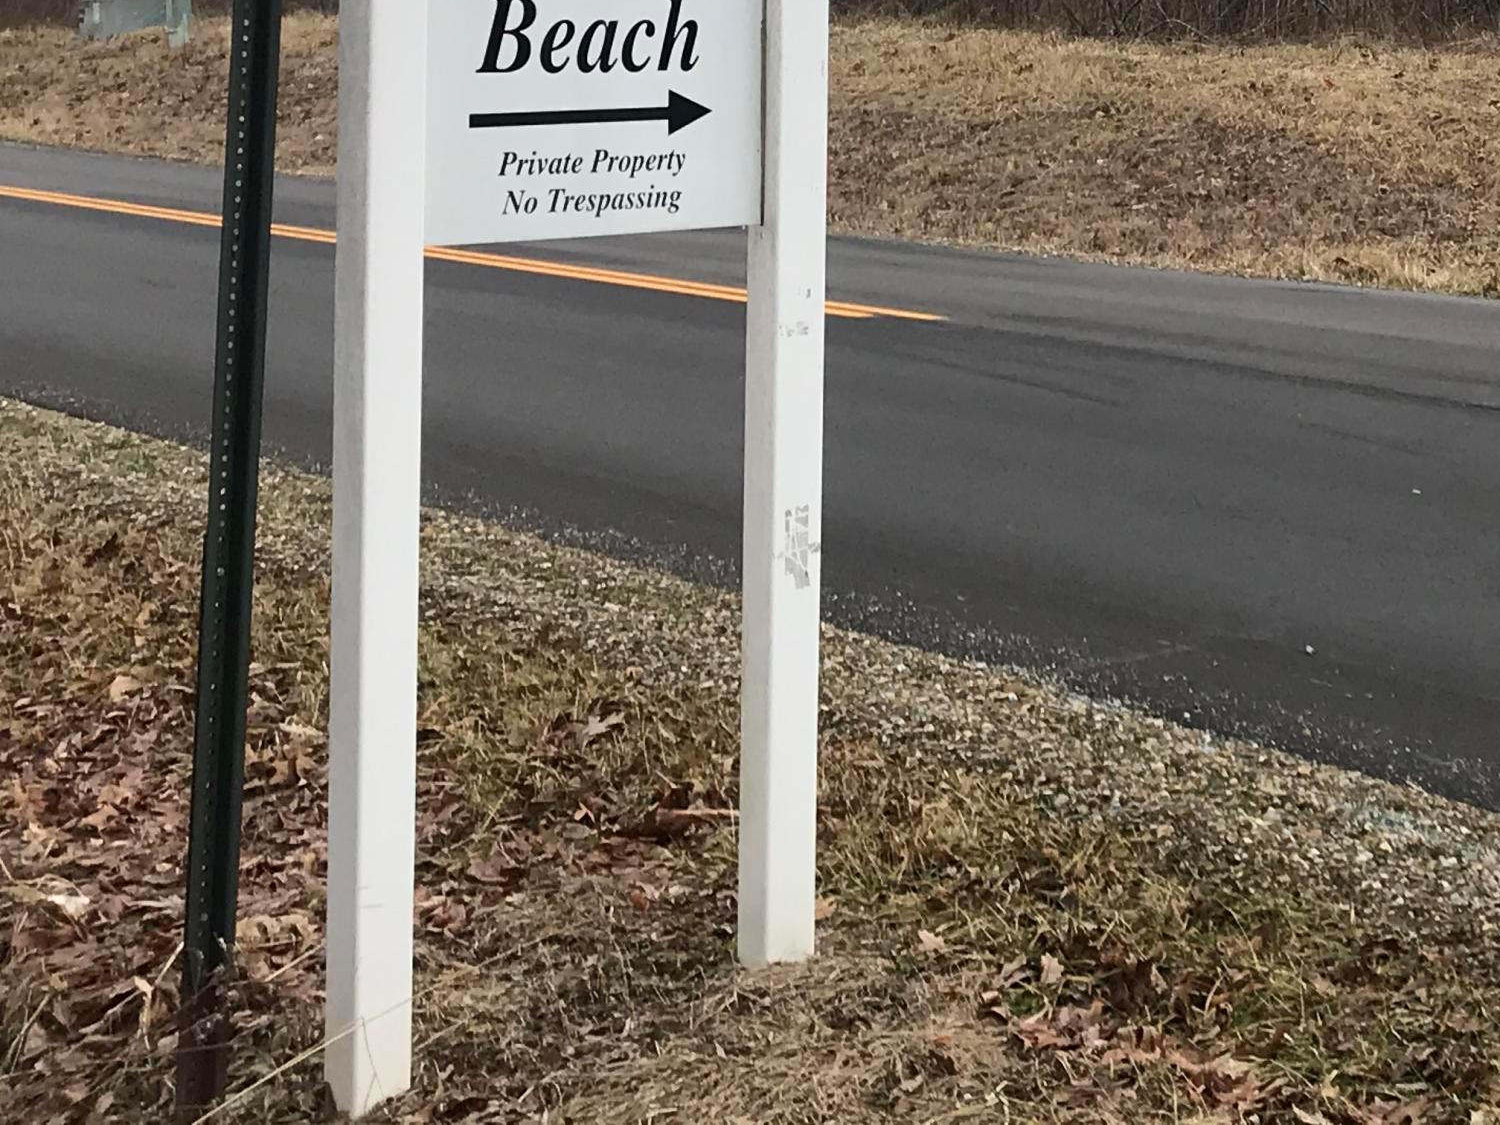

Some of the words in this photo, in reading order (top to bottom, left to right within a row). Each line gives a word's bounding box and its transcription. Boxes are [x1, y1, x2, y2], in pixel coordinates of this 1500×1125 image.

[498, 150, 583, 177] Private
[590, 149, 686, 179] Property
[502, 189, 538, 215] No
[548, 184, 682, 218] Trespassing
